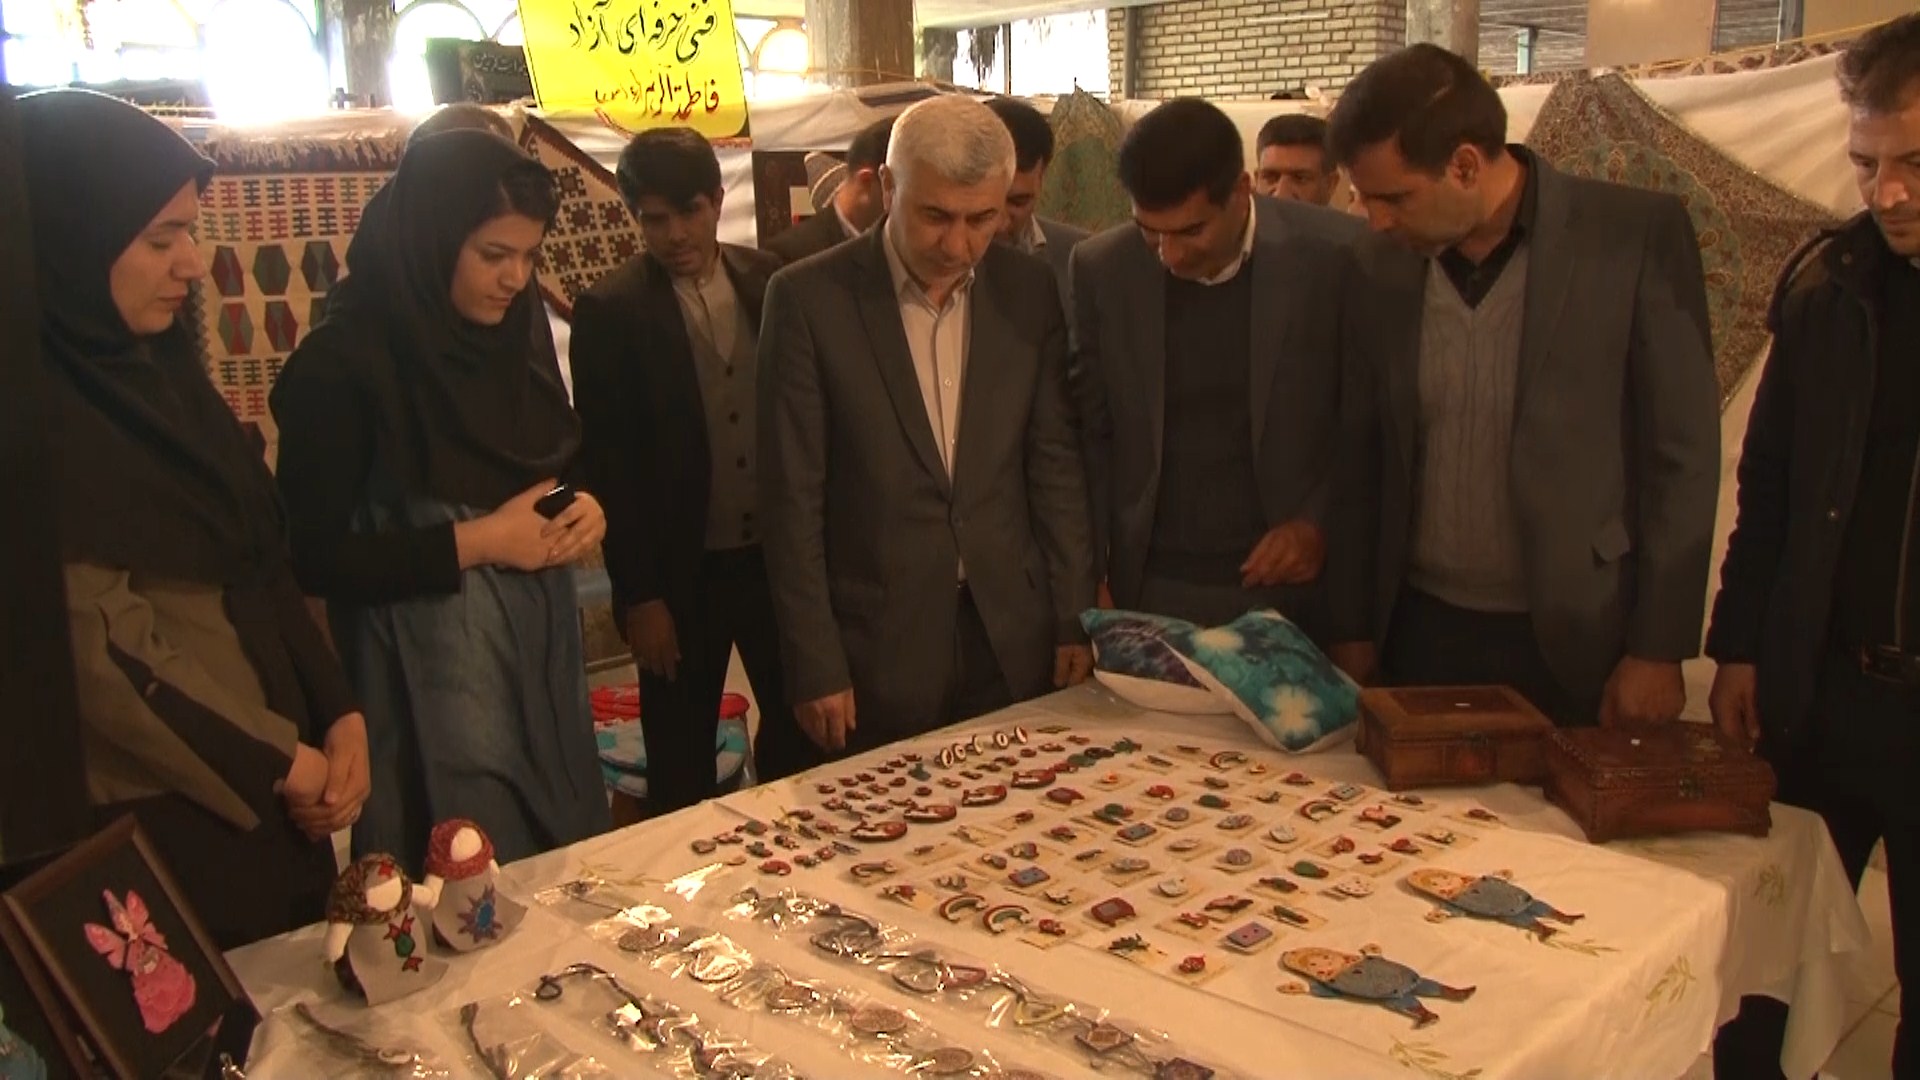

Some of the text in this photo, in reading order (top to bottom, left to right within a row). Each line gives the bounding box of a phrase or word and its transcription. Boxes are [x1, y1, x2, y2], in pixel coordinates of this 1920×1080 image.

[570, 0, 717, 64] فنی حرفه ای آزاد
